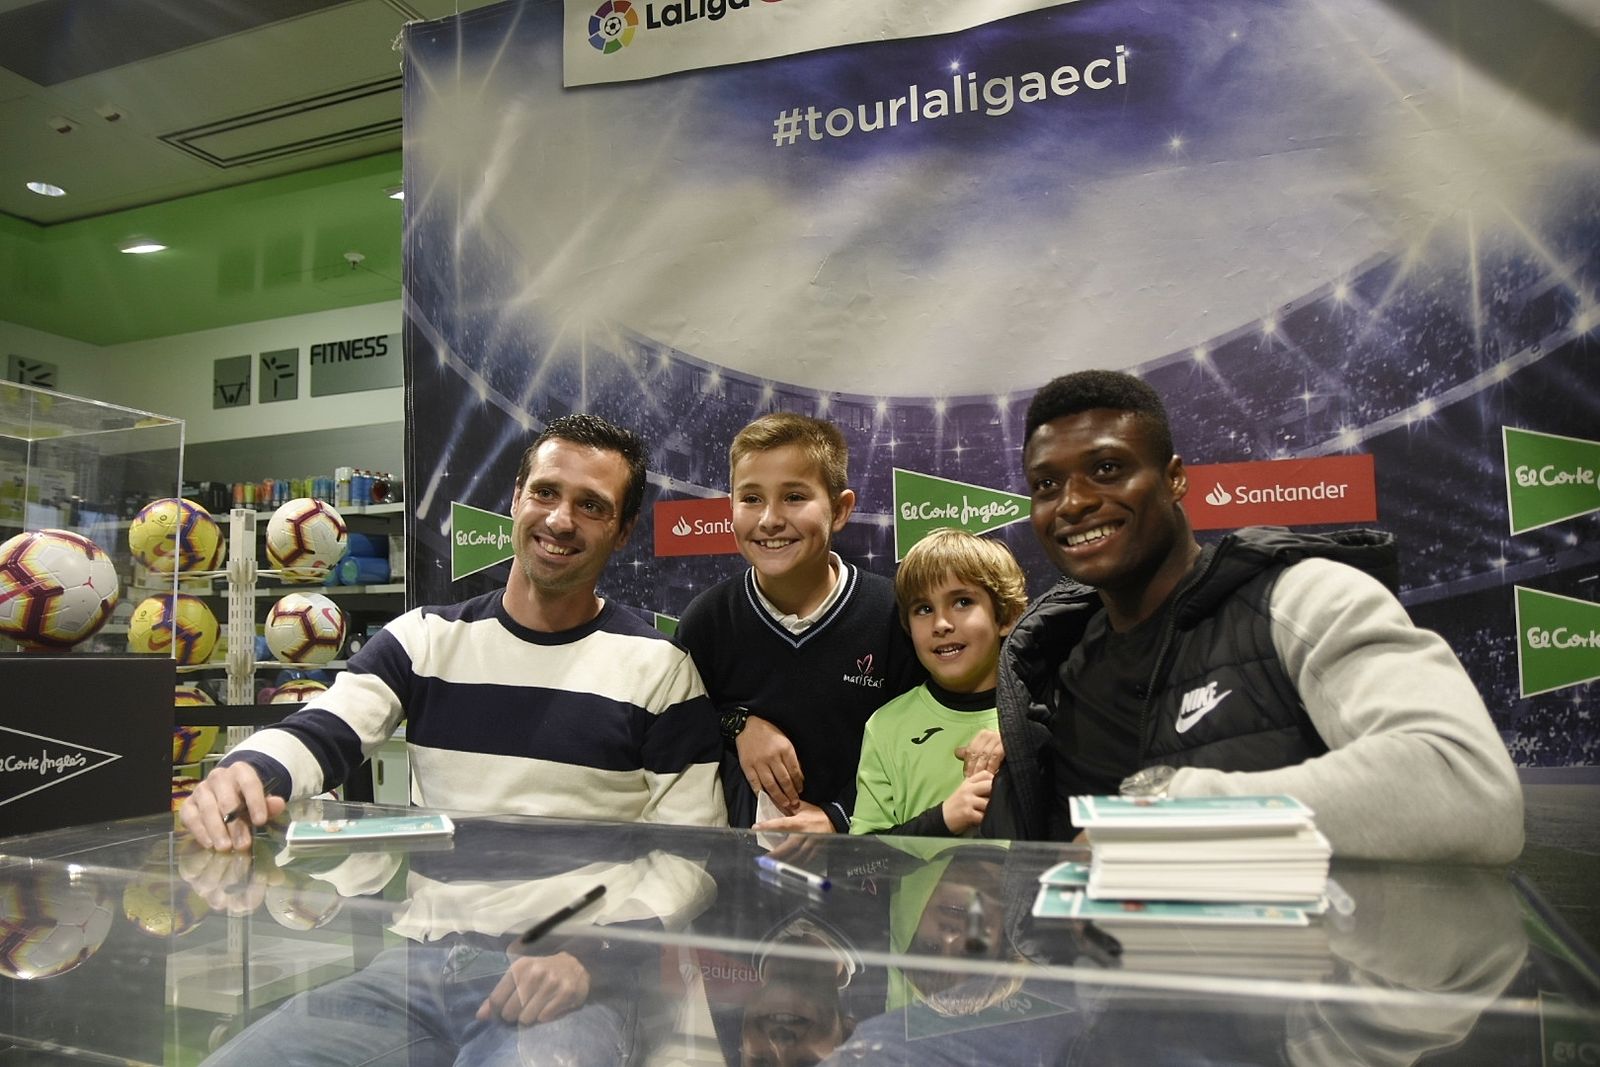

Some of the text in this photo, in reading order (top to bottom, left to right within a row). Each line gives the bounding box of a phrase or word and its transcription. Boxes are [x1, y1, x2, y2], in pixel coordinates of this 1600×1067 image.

[772, 44, 1127, 147] #tourlaligaeci
[310, 334, 388, 366] FITNESS
[1514, 464, 1539, 487] El
[1539, 464, 1595, 487] Corte
[1234, 481, 1349, 505] Santander
[900, 501, 919, 521] El
[918, 501, 960, 520] Corte
[468, 530, 497, 545] Corte
[1526, 626, 1551, 649] El
[843, 673, 885, 688] maristas
[1180, 681, 1218, 715] NIKE
[4, 755, 39, 772] Corte
